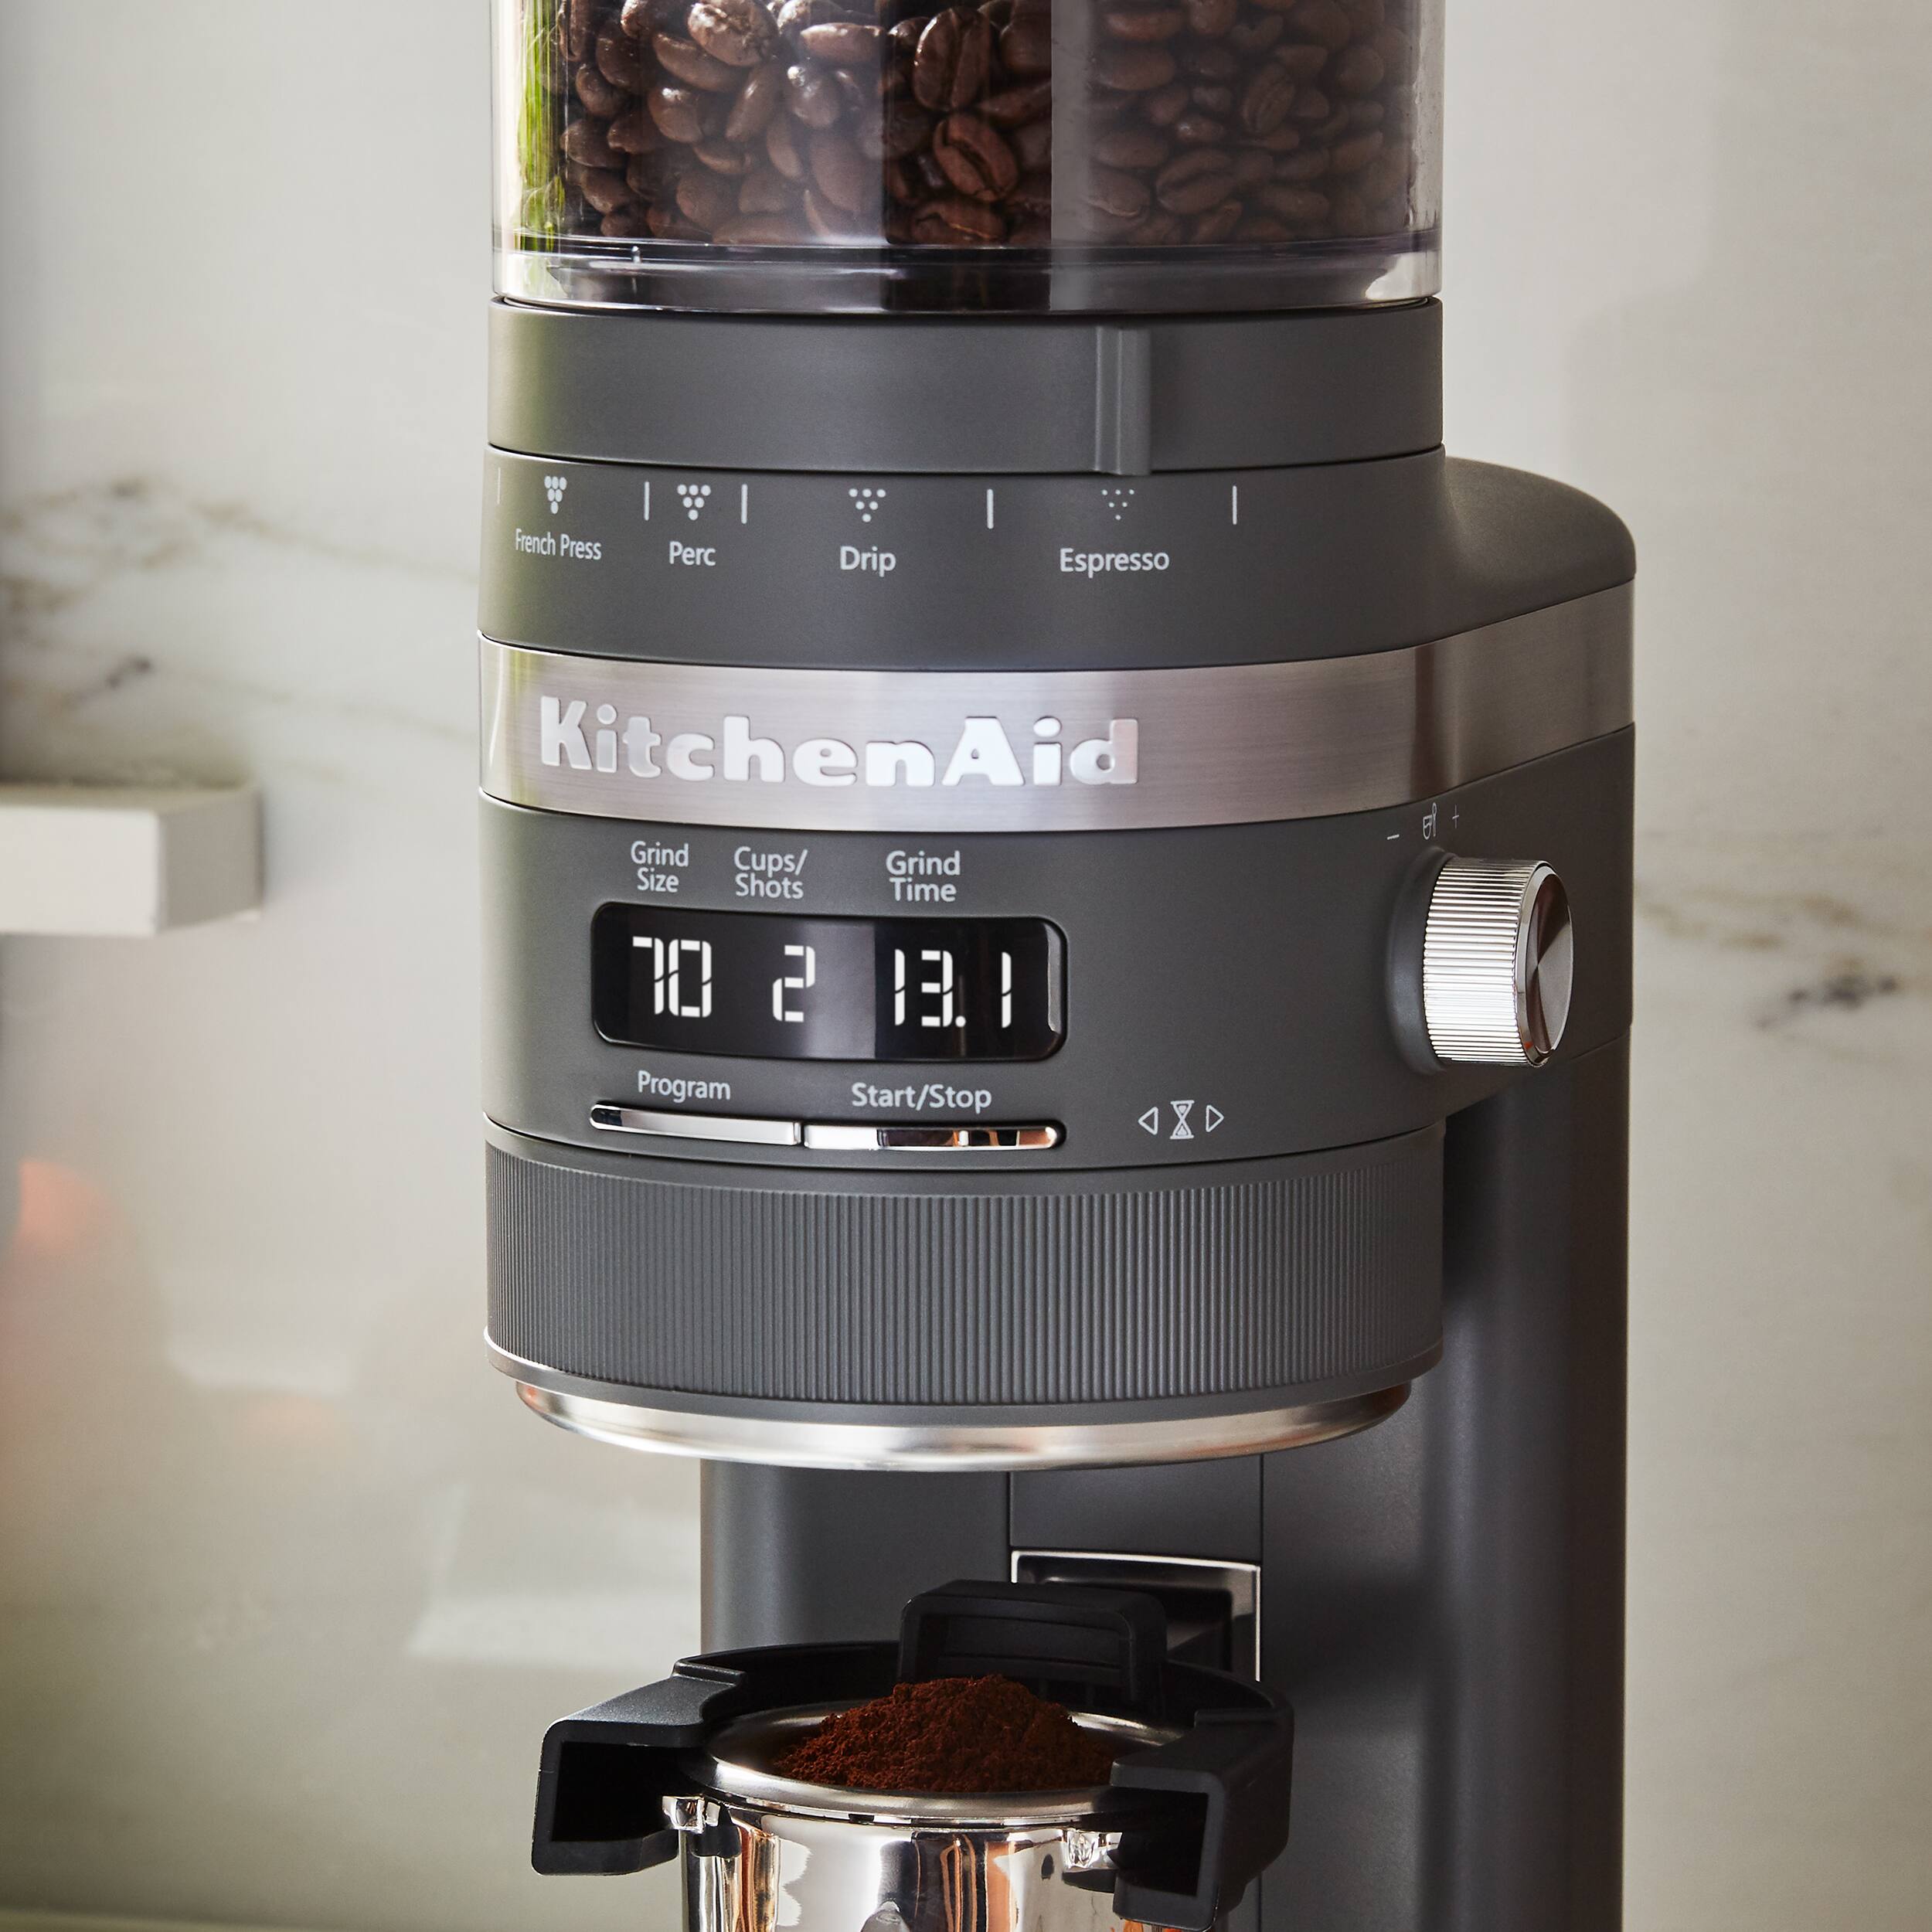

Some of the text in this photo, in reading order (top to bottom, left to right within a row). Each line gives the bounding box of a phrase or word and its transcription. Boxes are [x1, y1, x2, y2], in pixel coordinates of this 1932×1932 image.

[515, 528, 603, 561] French Press
[669, 540, 717, 567] Perc
[840, 546, 896, 577] Drip
[1060, 547, 1170, 579] Espresso
[540, 696, 1139, 786] KitchenAid
[631, 840, 689, 867] Grind
[734, 846, 808, 876] Cups/
[886, 850, 961, 876] Grind
[637, 866, 679, 893] Size
[735, 872, 804, 900] Shots
[889, 877, 957, 903] Time
[632, 936, 712, 1019] 70
[773, 945, 816, 1022] 2
[638, 1070, 731, 1103] Program
[851, 1082, 992, 1114] Start/Stop
